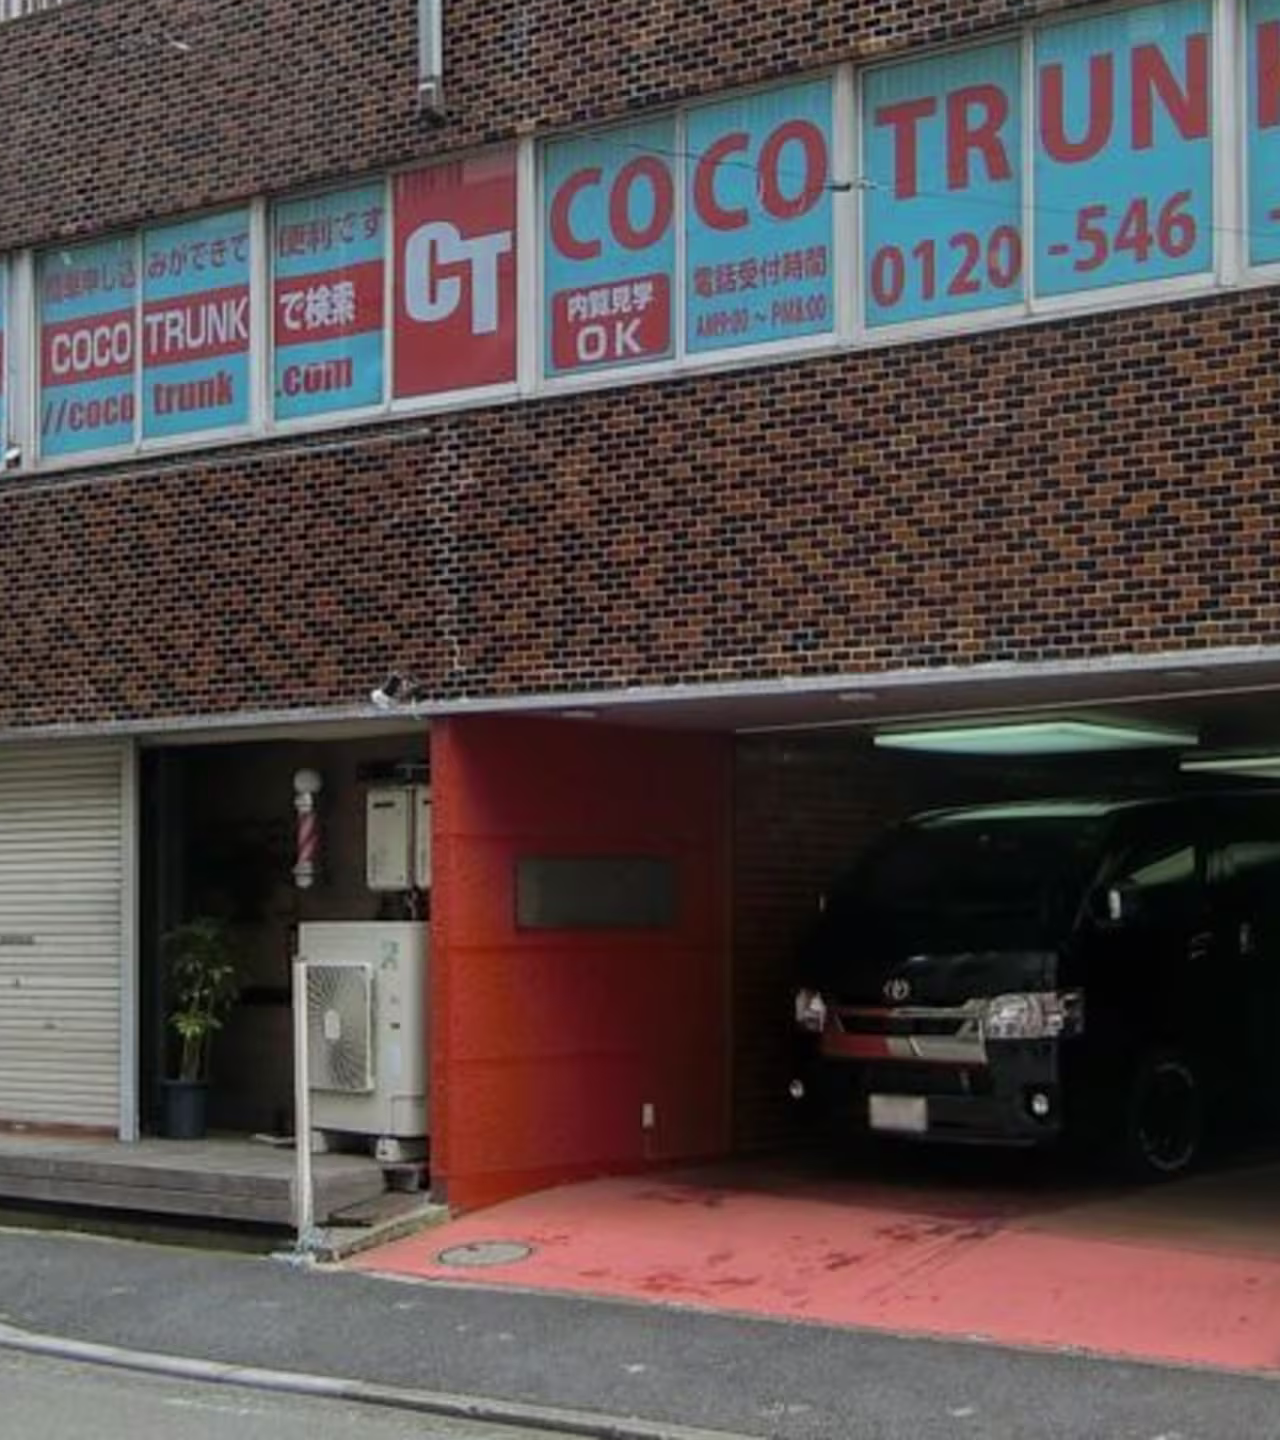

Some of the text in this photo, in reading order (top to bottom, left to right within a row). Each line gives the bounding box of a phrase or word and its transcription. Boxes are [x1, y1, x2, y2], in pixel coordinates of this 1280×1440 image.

[550, 119, 829, 260] COCO
[404, 220, 512, 336] CT
[51, 321, 132, 375] COCO
[145, 295, 250, 356] TRUNK
[577, 317, 642, 361] OK
